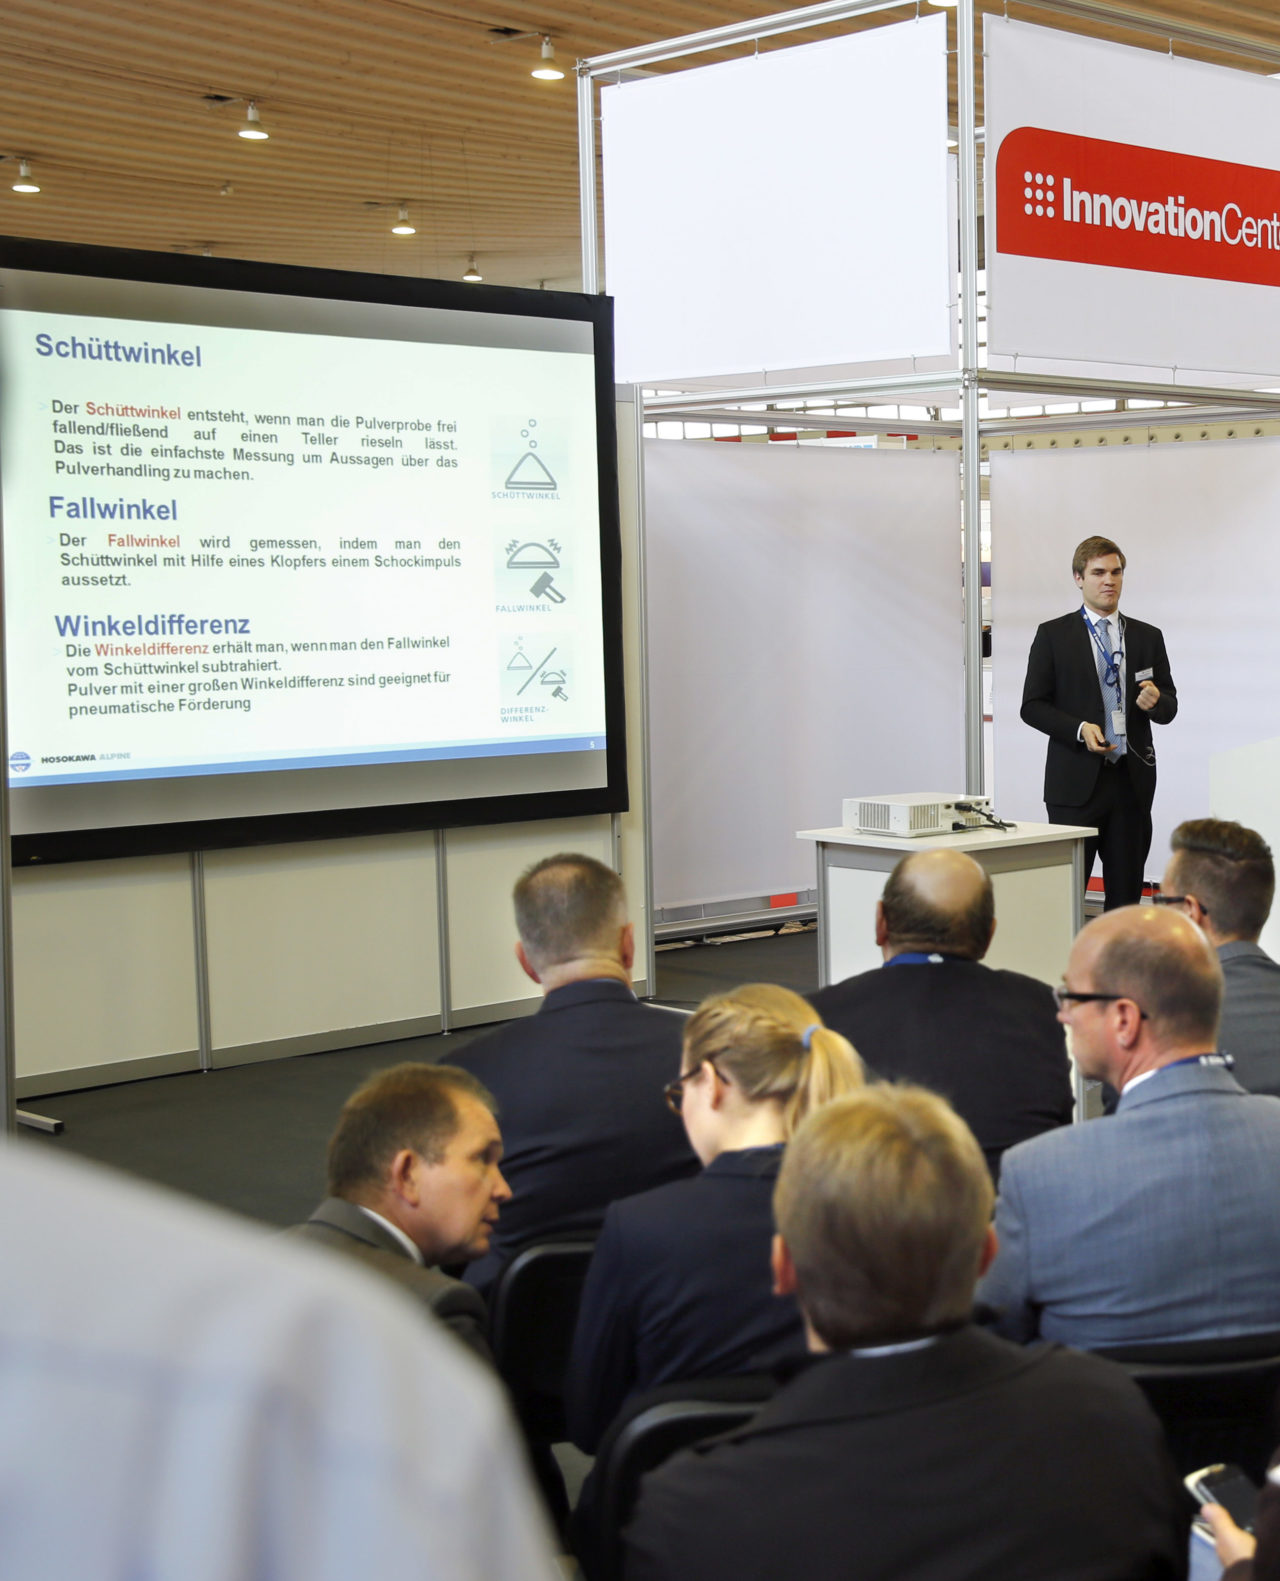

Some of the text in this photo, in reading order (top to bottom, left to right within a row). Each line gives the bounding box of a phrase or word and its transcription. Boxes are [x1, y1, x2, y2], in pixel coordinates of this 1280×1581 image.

[36, 333, 201, 367] Schüttwinkel
[51, 399, 457, 437] Der Schüttwinkel entsteht, wenn man die Pulverprobe frei
[52, 420, 458, 451] fallend/fließend auf einen Teller rieseln lässt.
[53, 439, 459, 469] Das ist die einfachste Messung um Aussagen über das
[55, 460, 254, 481] Pulverhandling zu machen.
[490, 490, 561, 501] SCHÜTTWINKEL
[49, 496, 177, 520] Fallwinkel
[59, 532, 461, 553] Der Fallwinkel wird gemessen, indem man den
[59, 552, 462, 571] Schüttwinkel mit Hilfe eines Klopfers einem Schockimpuls
[61, 573, 132, 587] aussetzt.
[495, 603, 553, 614] FALLWINKEL
[55, 614, 250, 637] Winkeldifferenz
[65, 635, 450, 658] Die Winkeldifferenz erhält man, wenn man den Fallwinkel
[66, 658, 282, 677] vom Schüttwinkel subtrahiert.
[67, 670, 451, 697] Pulver mit einer großen Winkeldifferenz sind geeignet für
[69, 697, 251, 719] pneumatische Förderung
[499, 705, 549, 716] DIFFERENZ-
[500, 714, 535, 724] WINKEL
[589, 740, 595, 749] 5
[40, 751, 132, 764] HOSOKAWA ALPINE
